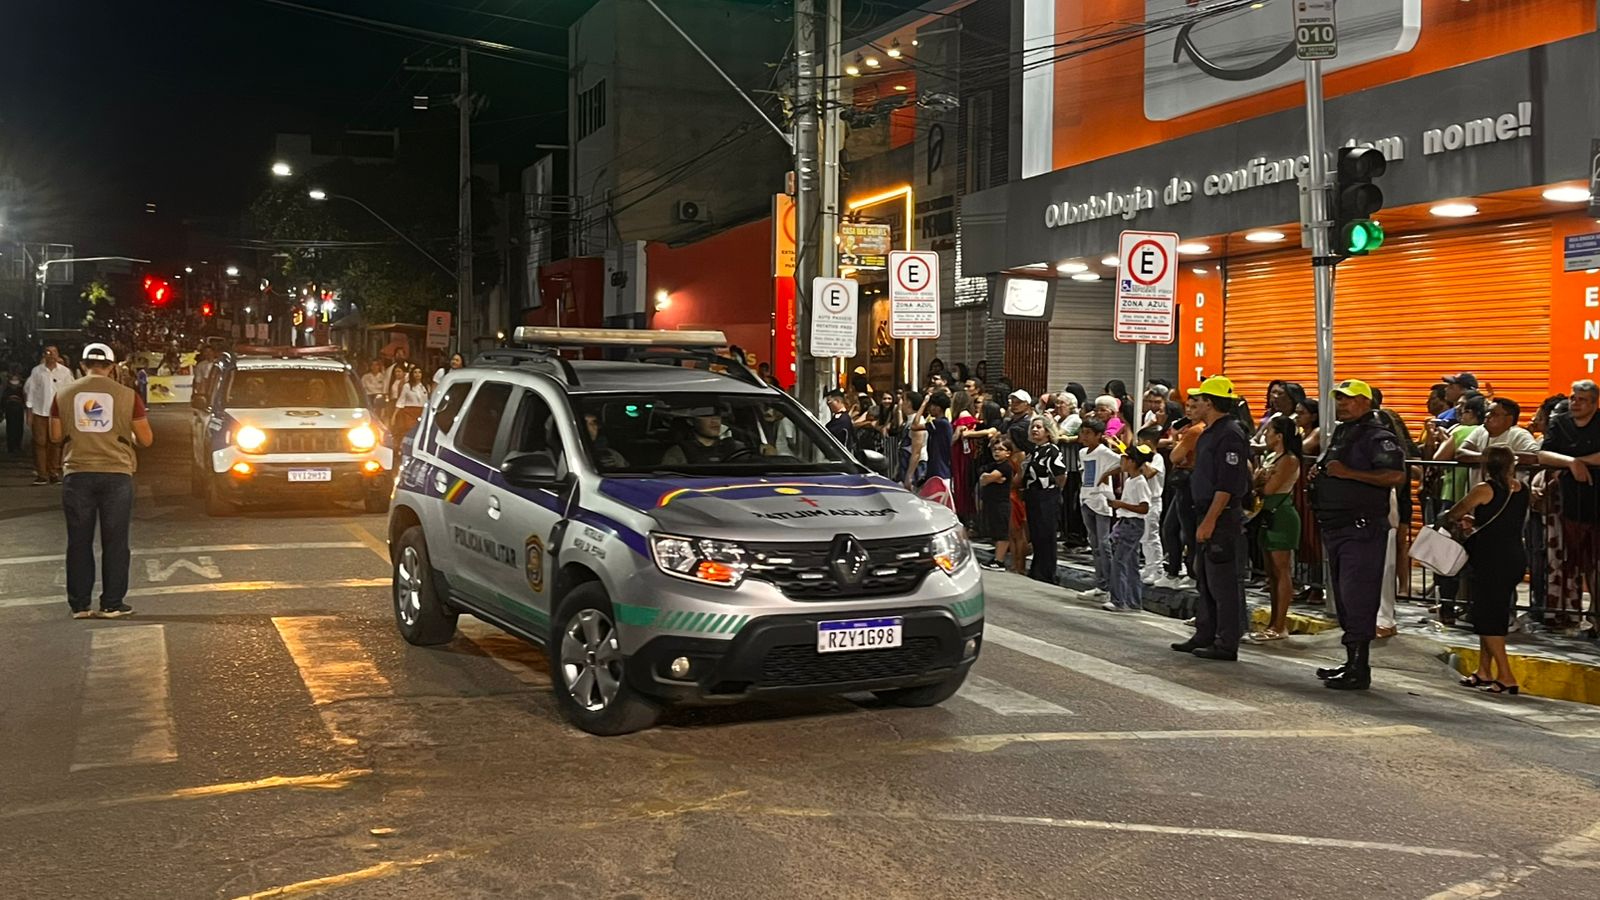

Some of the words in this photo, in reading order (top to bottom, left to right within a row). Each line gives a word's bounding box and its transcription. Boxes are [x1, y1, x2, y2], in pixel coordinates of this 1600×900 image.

[1298, 26, 1334, 43] 010
[1045, 185, 1154, 229] Odontologia
[1163, 177, 1193, 206] de
[1423, 101, 1532, 155] nome!
[1141, 251, 1154, 274] E
[908, 265, 919, 283] E
[830, 290, 840, 306] E
[483, 538, 518, 569] MILITAR
[829, 628, 894, 649] RZY1G98
